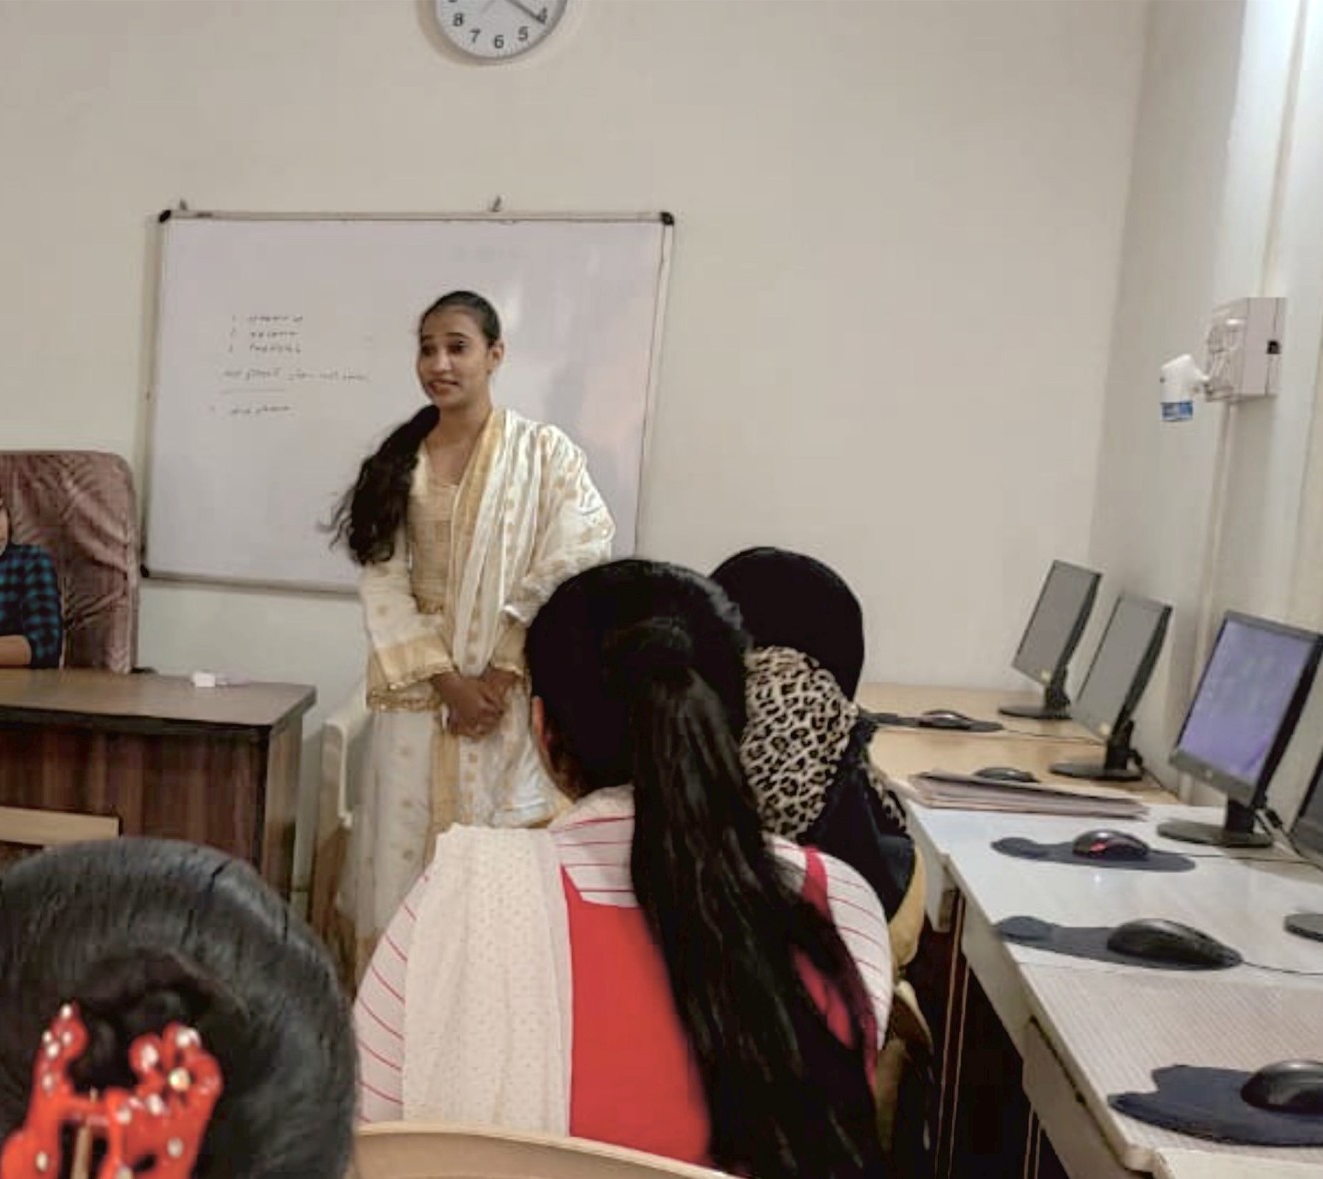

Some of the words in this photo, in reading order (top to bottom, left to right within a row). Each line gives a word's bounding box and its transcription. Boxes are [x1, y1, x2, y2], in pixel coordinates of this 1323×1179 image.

[453, 12, 464, 27] 8
[470, 28, 480, 43] 7
[518, 26, 529, 41] 5
[494, 34, 504, 49] 6
